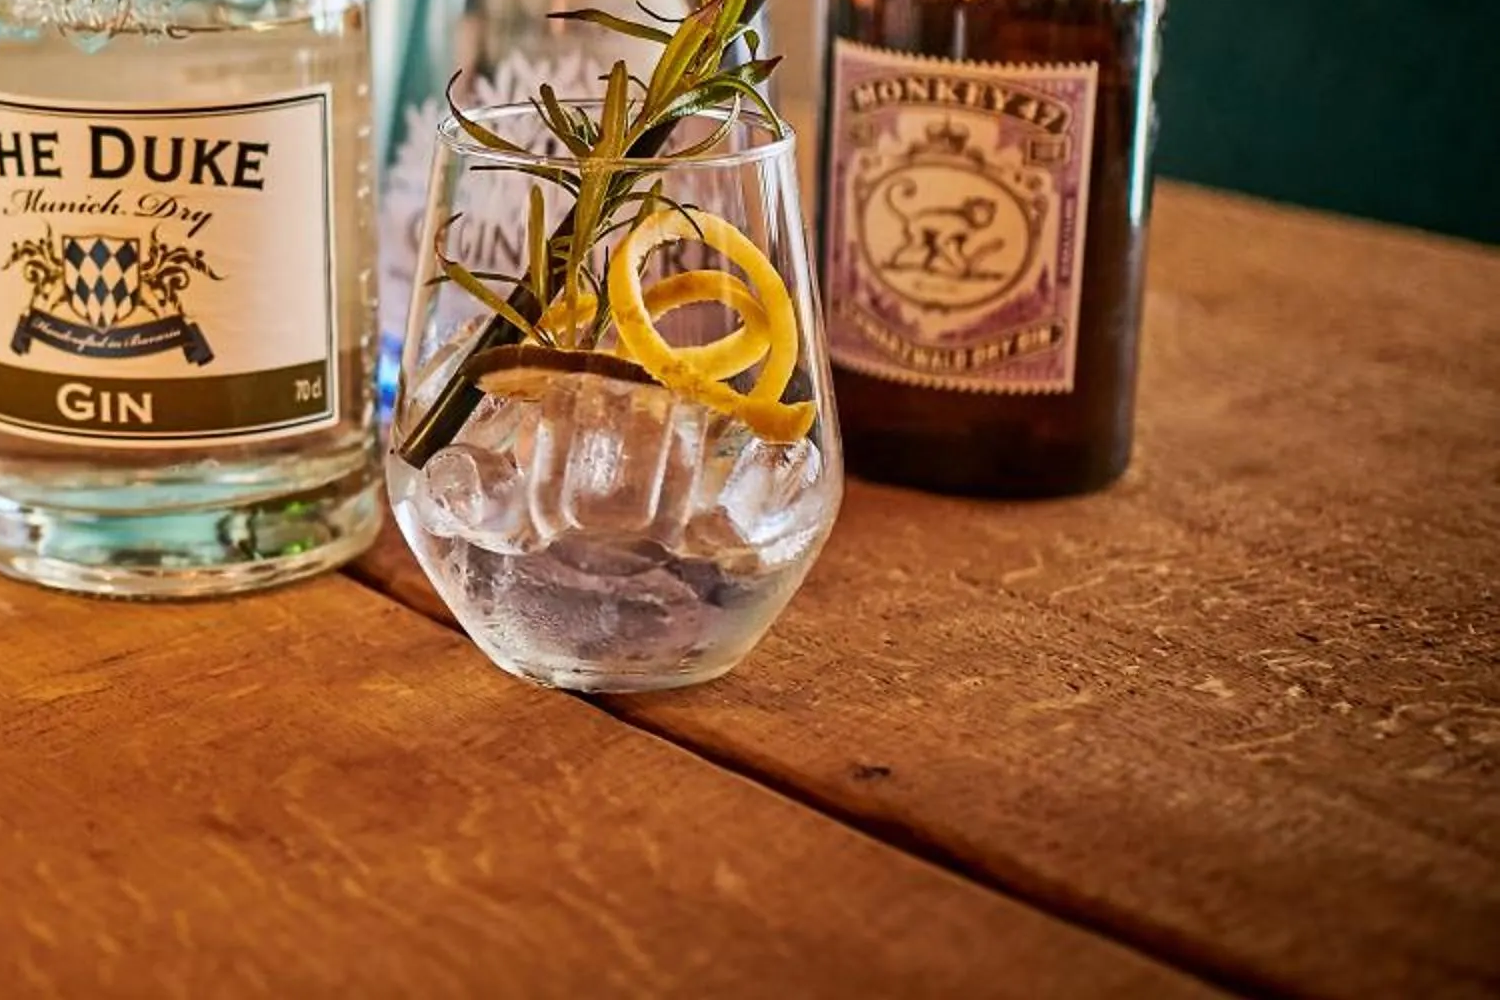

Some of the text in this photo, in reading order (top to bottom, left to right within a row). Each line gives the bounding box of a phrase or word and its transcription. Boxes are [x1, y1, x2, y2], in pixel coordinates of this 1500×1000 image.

[852, 76, 1063, 128] MONKEY 47
[88, 124, 269, 191] DUKE
[3, 187, 213, 239] Munich Dry
[56, 382, 153, 424] GIN
